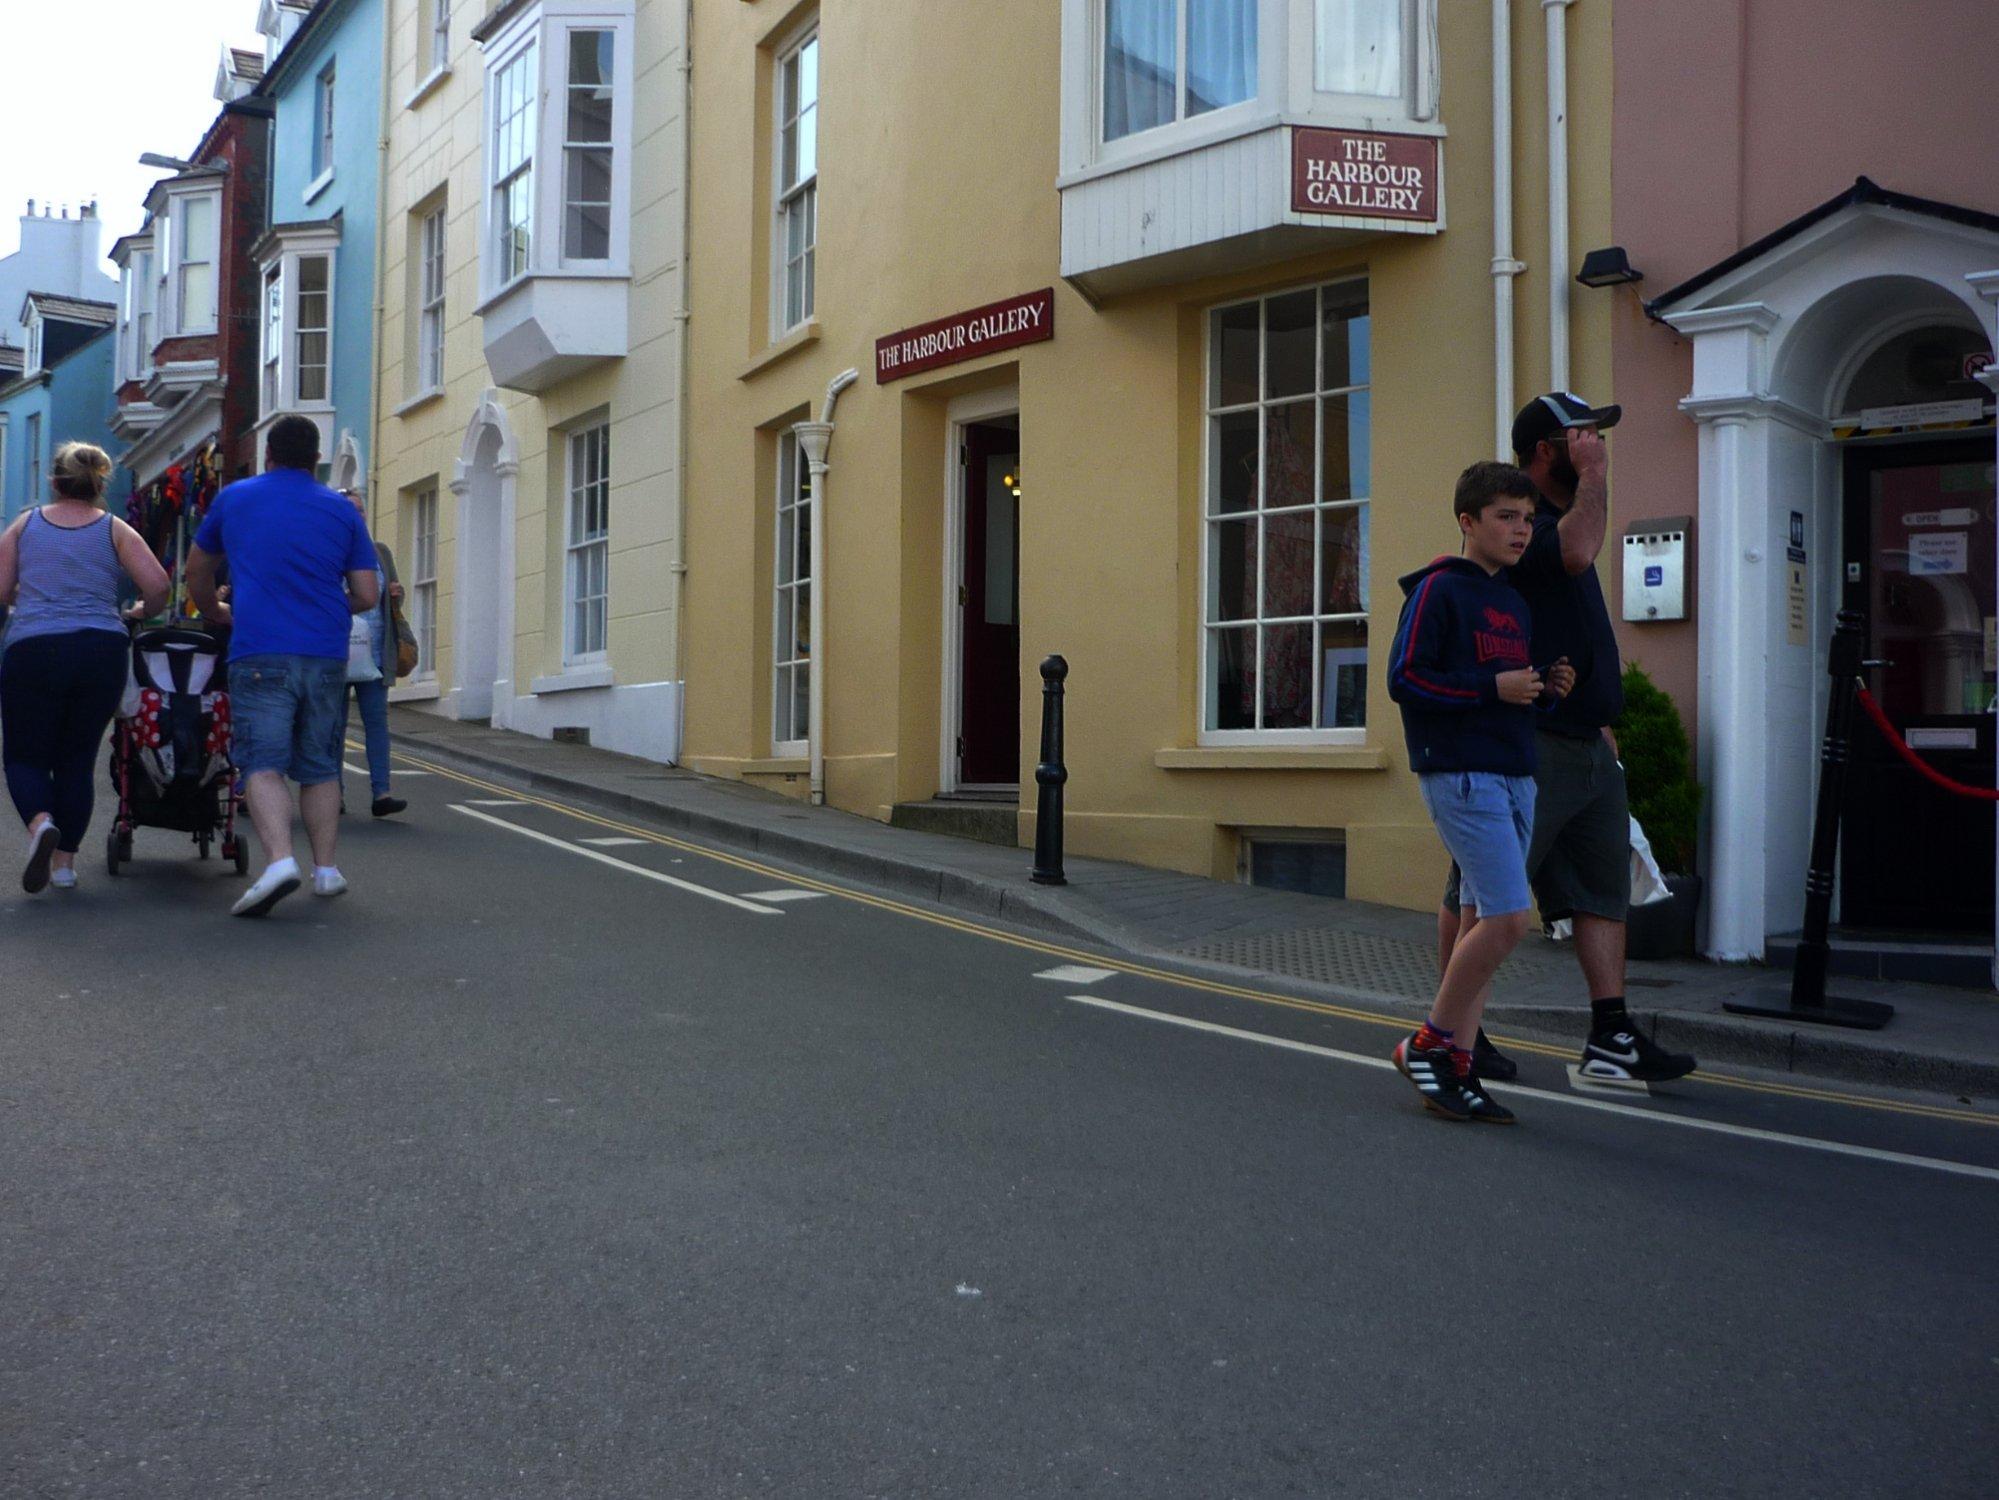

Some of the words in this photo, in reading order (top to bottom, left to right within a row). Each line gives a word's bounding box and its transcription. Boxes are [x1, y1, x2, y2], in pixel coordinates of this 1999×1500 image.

[1342, 139, 1386, 162] THE
[1306, 159, 1423, 188] HARBOUR
[1306, 182, 1423, 211] GALLERY
[878, 344, 900, 370] THE
[902, 325, 965, 363] HARBOUR
[968, 302, 1045, 343] GALLERY
